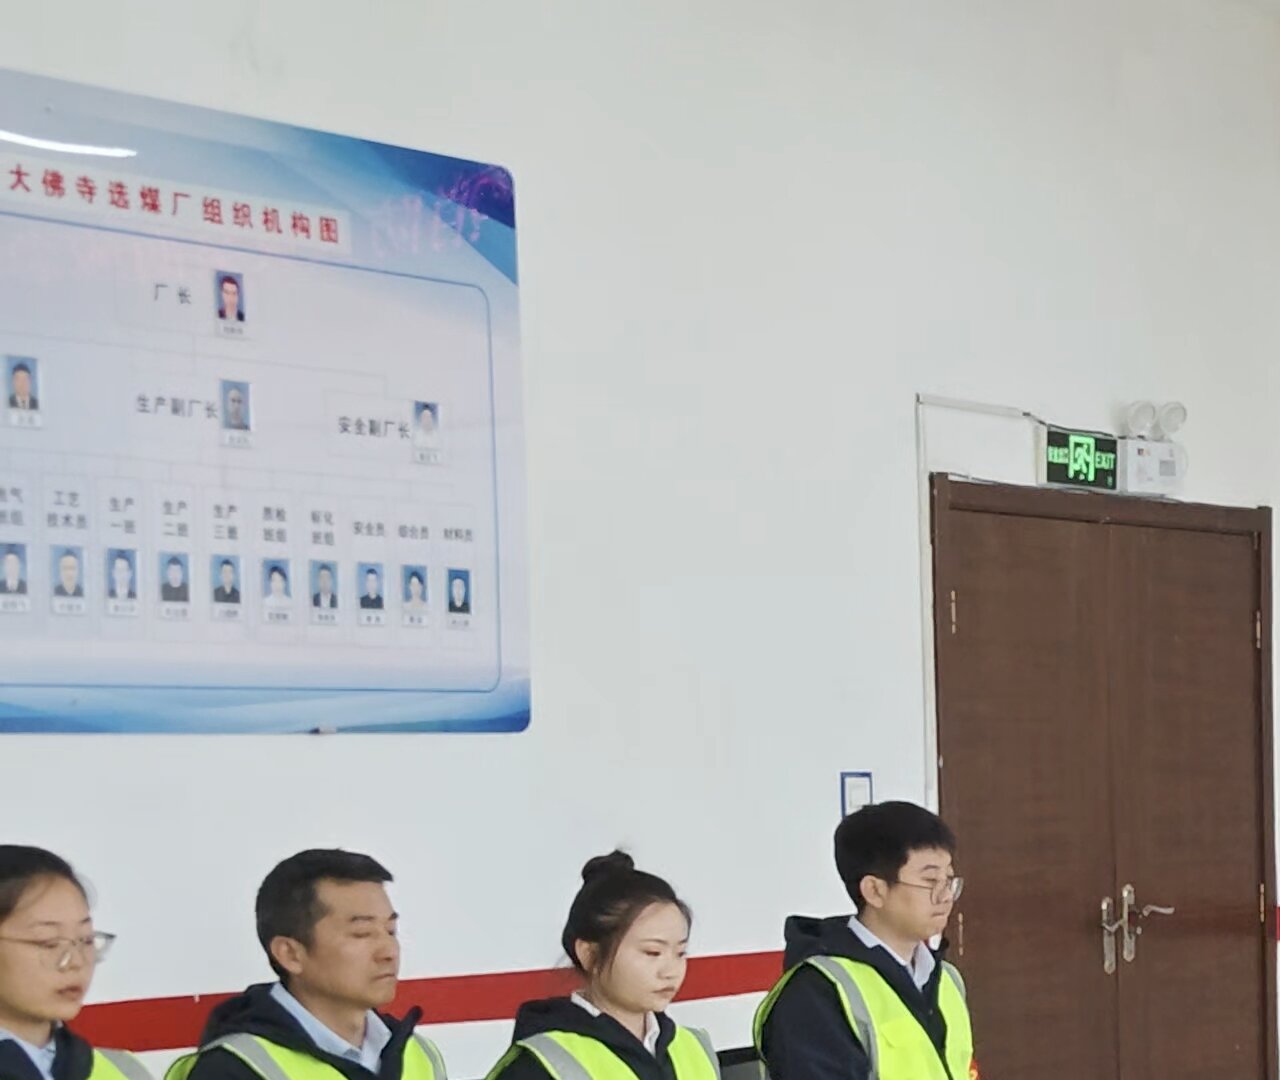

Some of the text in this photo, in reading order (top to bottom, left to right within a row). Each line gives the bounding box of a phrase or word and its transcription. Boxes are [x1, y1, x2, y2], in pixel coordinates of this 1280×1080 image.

[9, 163, 338, 243] 大佛寺选煤厂组织机构图
[1095, 451, 1115, 469] EXIT
